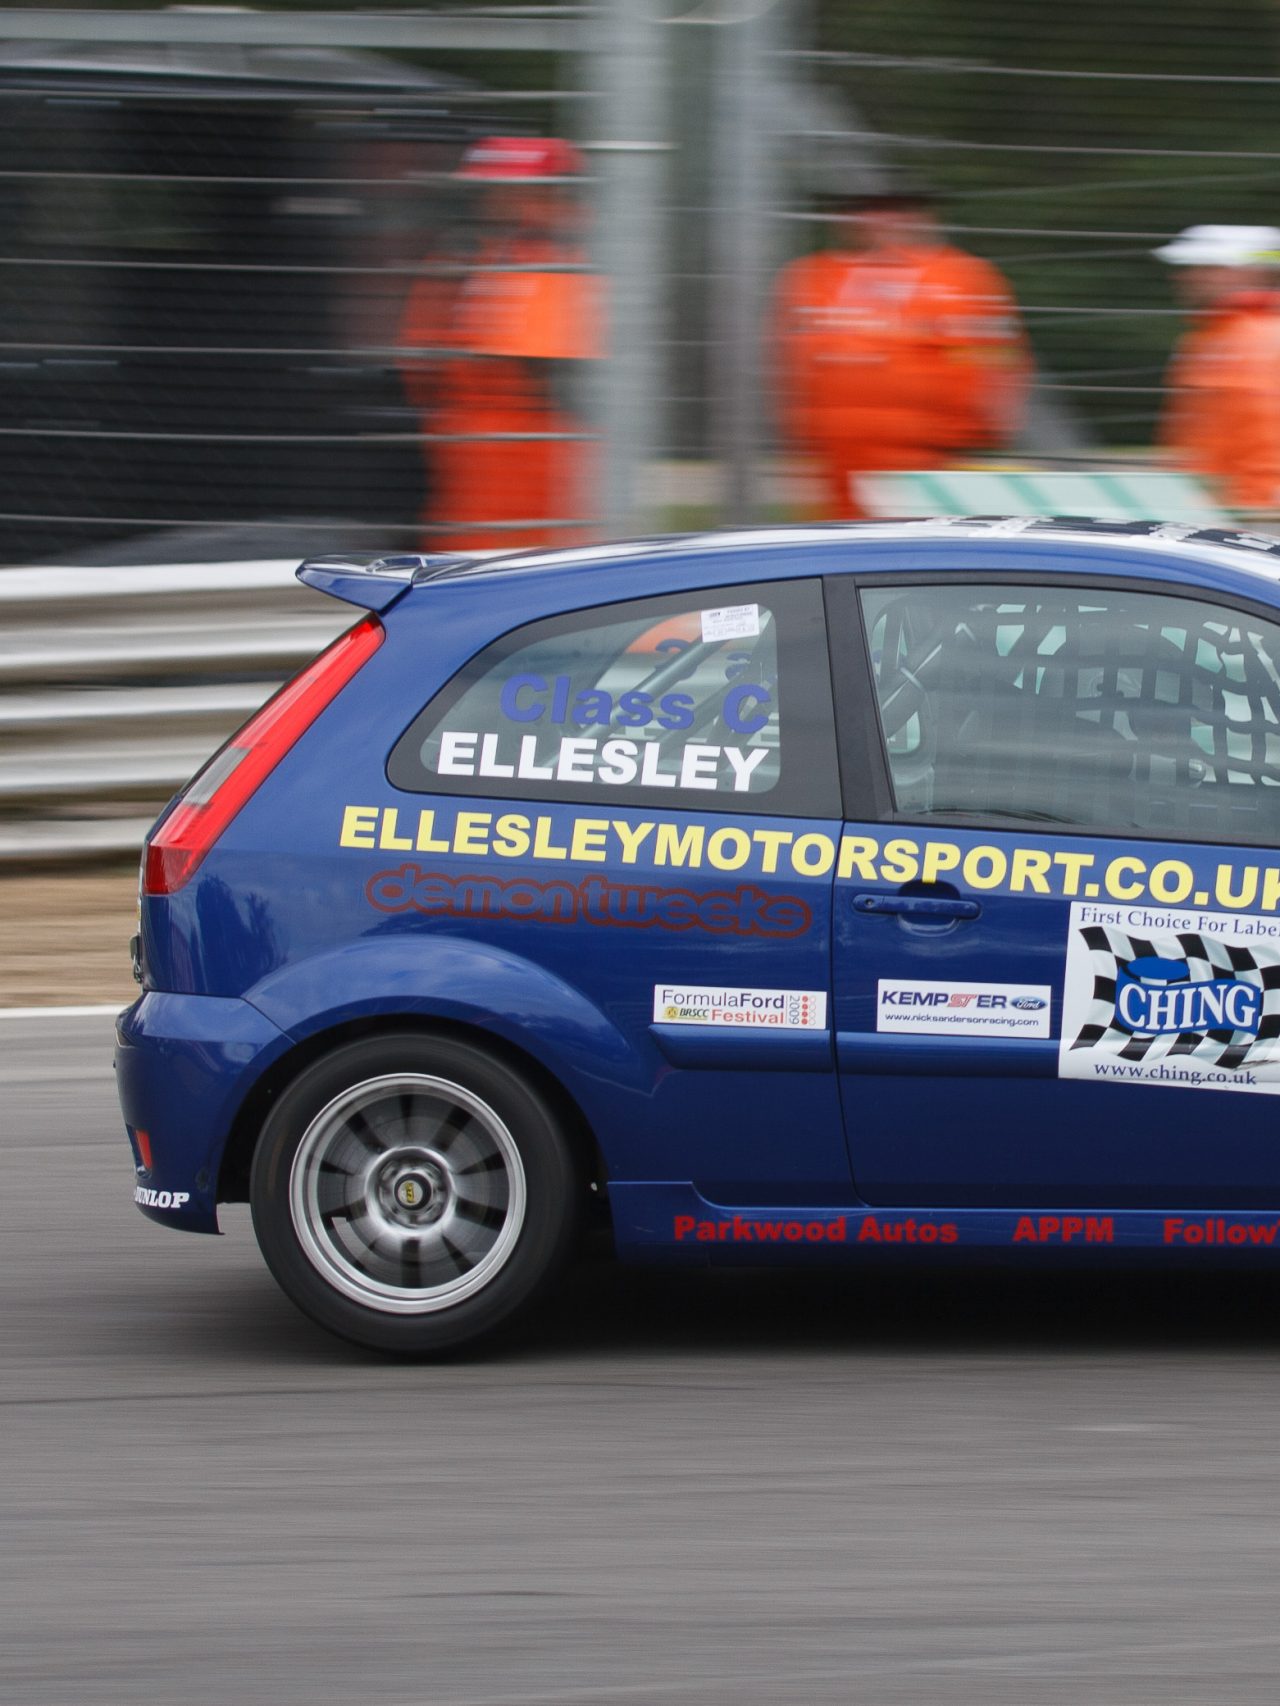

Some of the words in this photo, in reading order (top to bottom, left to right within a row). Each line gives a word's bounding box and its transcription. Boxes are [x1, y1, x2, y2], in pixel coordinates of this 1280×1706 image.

[500, 672, 695, 731] Class
[722, 682, 772, 735] C
[437, 731, 770, 793] ELLESLEY
[1080, 907, 1122, 925] First
[1127, 911, 1191, 931] Choice
[1197, 915, 1228, 934] For
[662, 989, 785, 1010] FormulaFord
[789, 995, 800, 1026] 2009
[881, 990, 1008, 1010] KEMPSTER
[1119, 983, 1257, 1031] CHING
[679, 1008, 709, 1019] BRSCC
[711, 1008, 784, 1024] Festival
[885, 1012, 1040, 1028] www.nicksandersonracing.com
[1094, 1062, 1257, 1085] www.ching.co.uk
[673, 1215, 847, 1242] Parkwood
[857, 1216, 960, 1243] Autos
[1012, 1216, 1115, 1243] APPM
